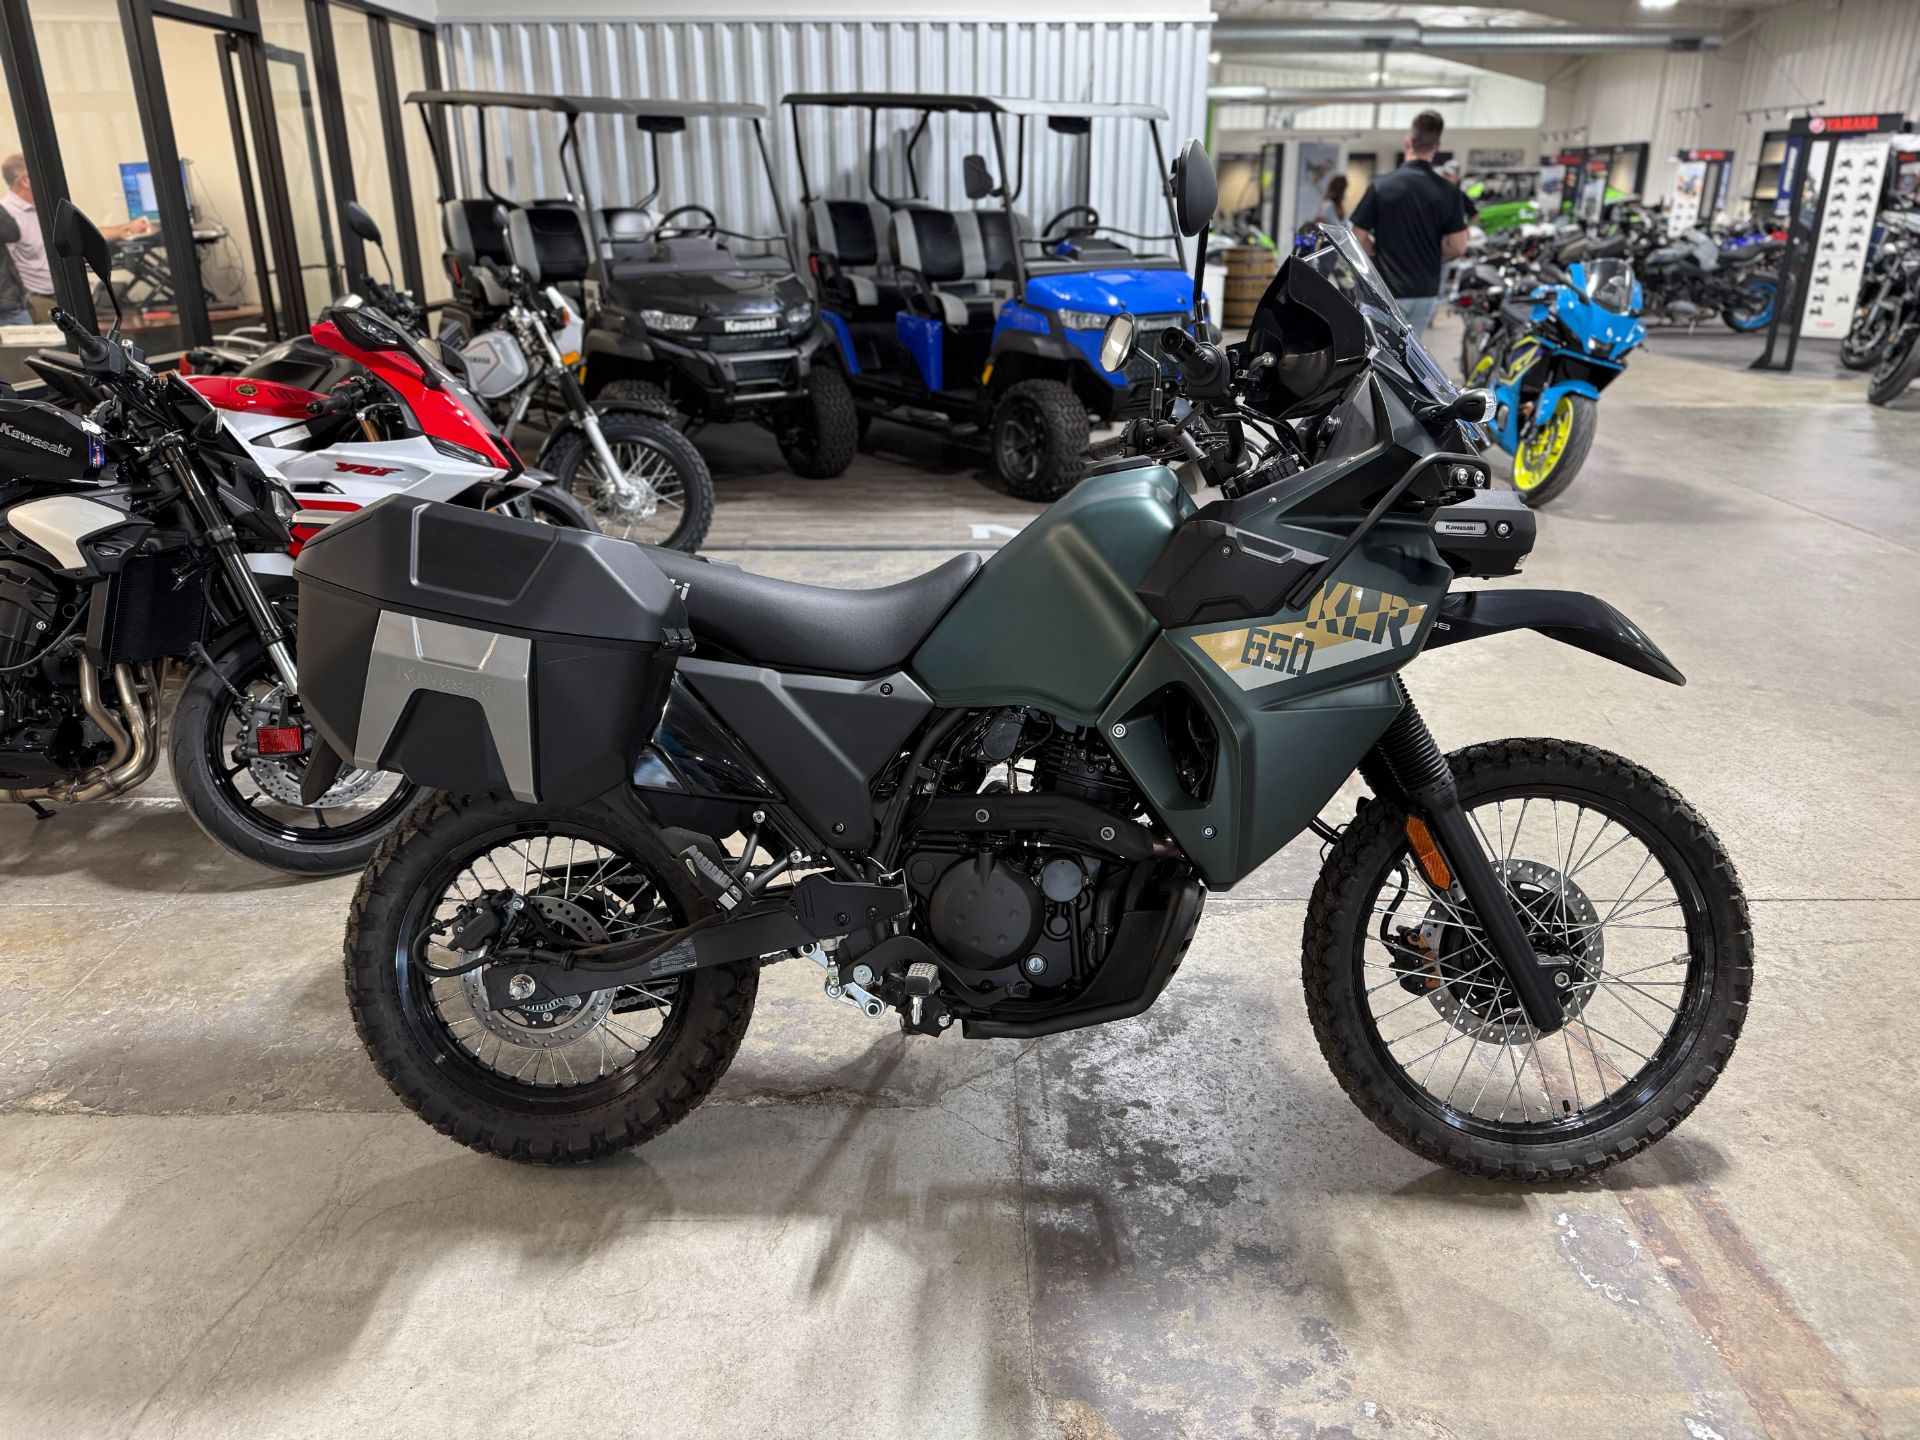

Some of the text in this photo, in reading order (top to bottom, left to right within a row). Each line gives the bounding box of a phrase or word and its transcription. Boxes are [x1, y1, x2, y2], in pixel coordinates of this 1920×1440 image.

[1825, 115, 1879, 132] YAMAHA
[724, 317, 777, 333] Kawasaki
[0, 422, 73, 458] Kawasaki
[1445, 523, 1476, 531] Kawasaki
[1305, 582, 1410, 649] KLR
[1241, 628, 1315, 676] 650
[401, 663, 497, 698] Kawasaki
